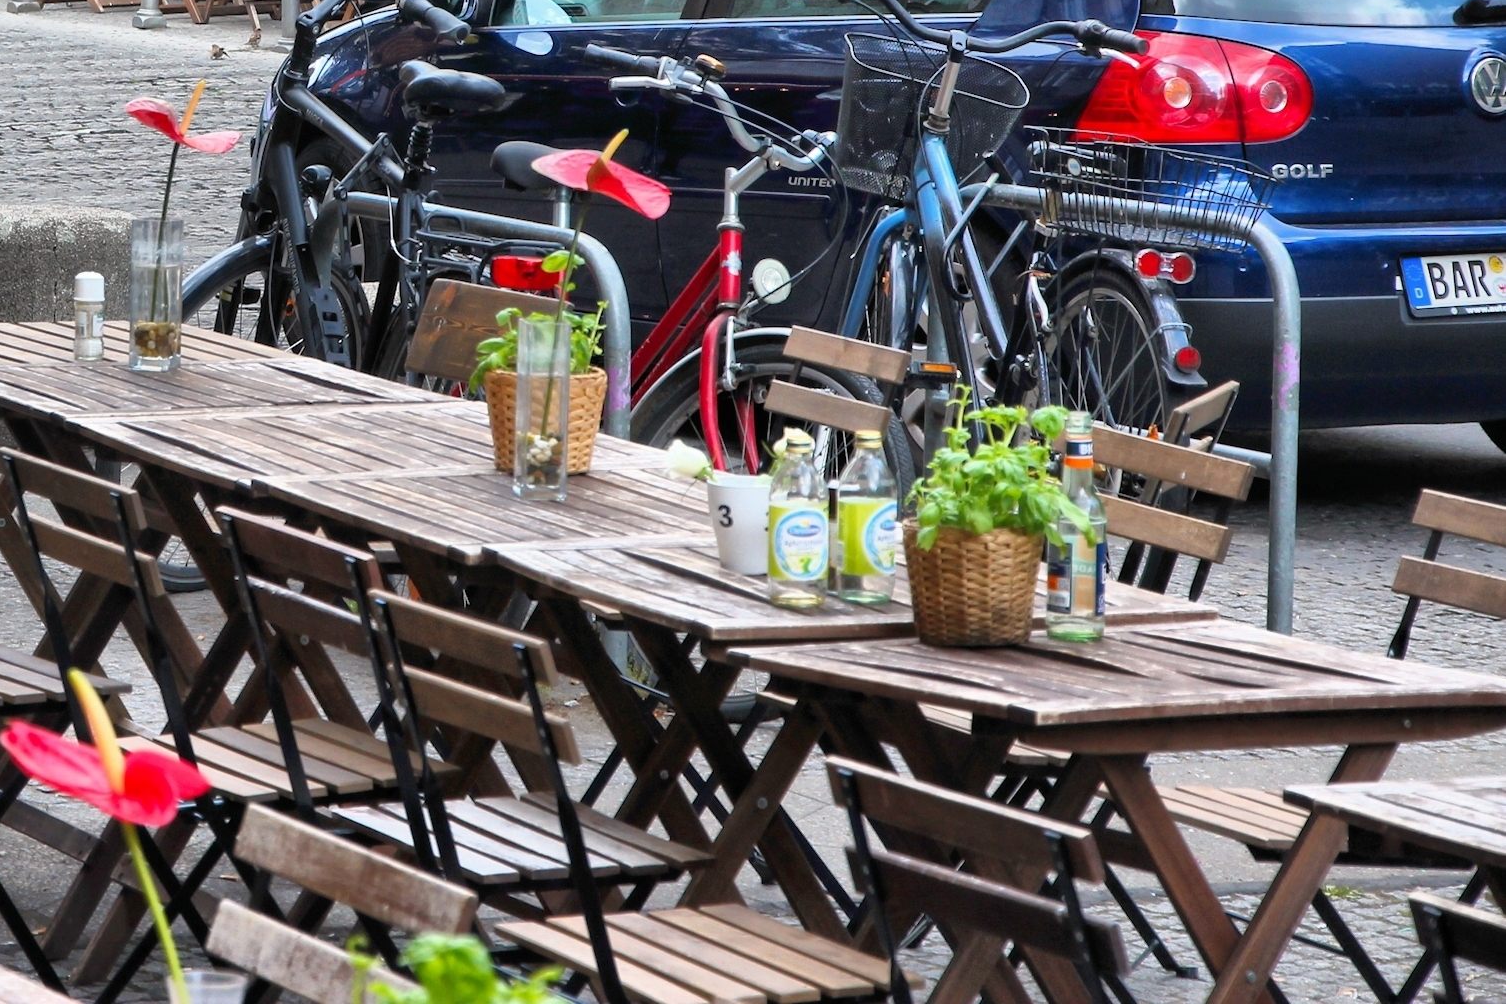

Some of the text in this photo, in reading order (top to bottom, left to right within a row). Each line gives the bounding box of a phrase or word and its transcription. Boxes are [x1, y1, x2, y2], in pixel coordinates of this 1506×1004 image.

[1272, 163, 1334, 179] GOLF
[788, 176, 837, 188] UNITED
[1414, 259, 1492, 300] D BAR
[718, 504, 734, 528] 3
